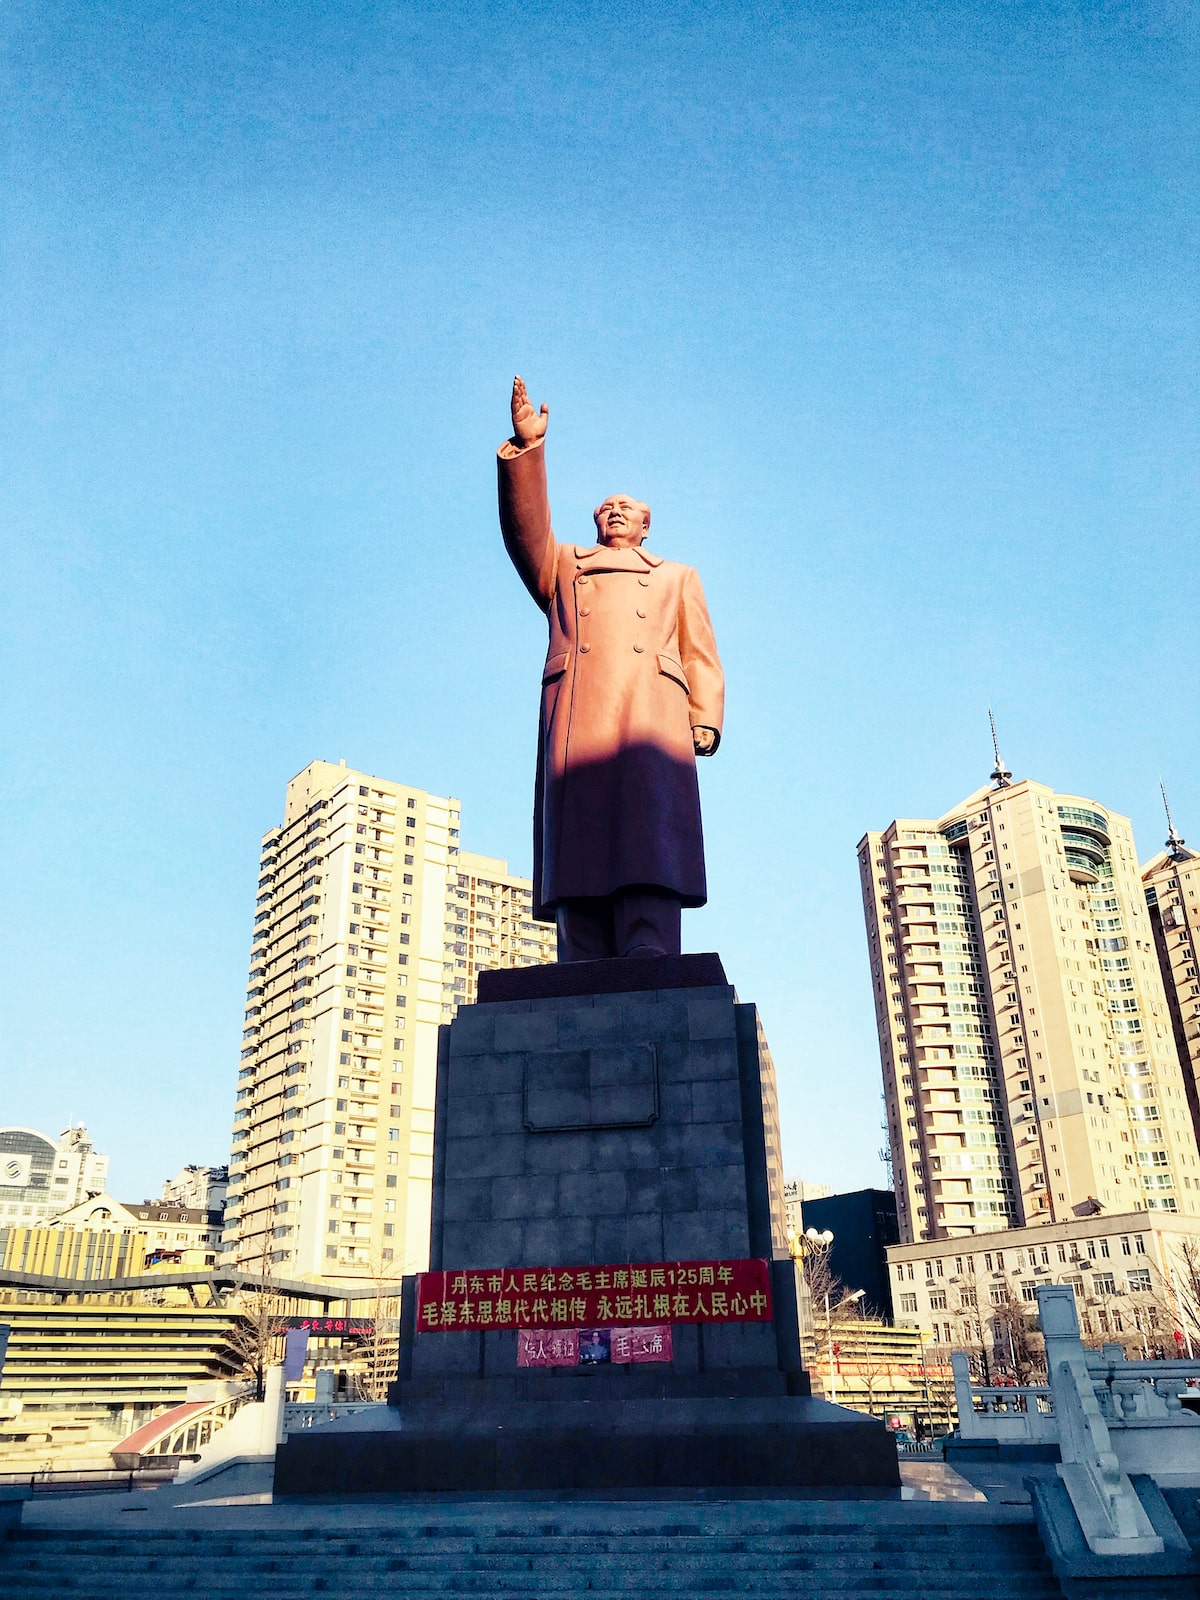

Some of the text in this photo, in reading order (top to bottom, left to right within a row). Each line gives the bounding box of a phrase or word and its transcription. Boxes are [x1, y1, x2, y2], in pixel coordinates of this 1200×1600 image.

[451, 1266, 734, 1295] 丹东市人民纪念毛主席诞辰125周年
[422, 1290, 767, 1326] 毛泽东思想代代相传 永远扎根在人民心中
